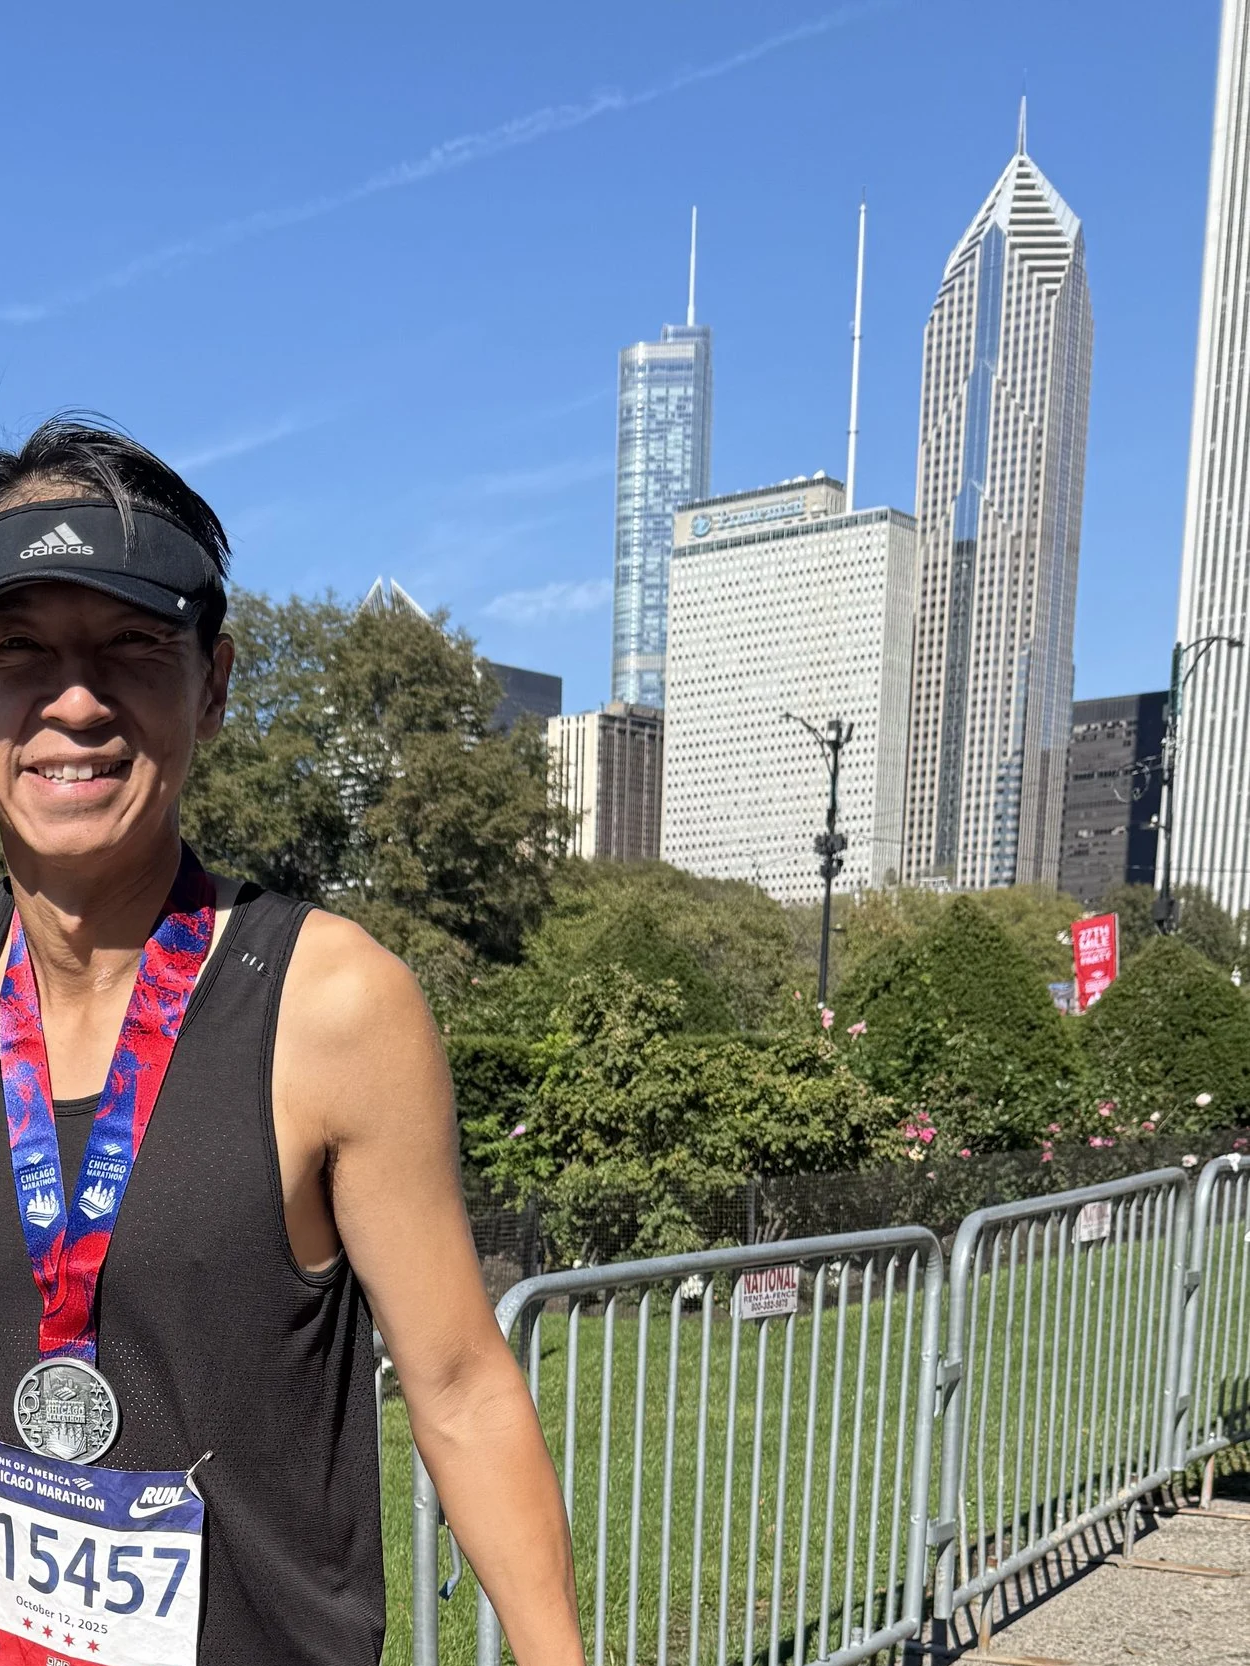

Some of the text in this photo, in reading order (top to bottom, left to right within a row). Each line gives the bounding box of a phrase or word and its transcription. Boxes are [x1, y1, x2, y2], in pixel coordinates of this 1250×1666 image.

[19, 543, 94, 560] adidas
[20, 1167, 56, 1184] CHICAGO
[86, 1168, 124, 1182] MARATHON
[88, 1159, 127, 1174] CHICAGO
[22, 1177, 57, 1191] MARATHON
[743, 1267, 796, 1294] NATIONAL
[13, 1460, 26, 1473] OF
[26, 1464, 72, 1487] AMERICA
[36, 1482, 105, 1512] MARATHON
[140, 1486, 184, 1505] RUN
[15, 1594, 109, 1635] October 12, 2025
